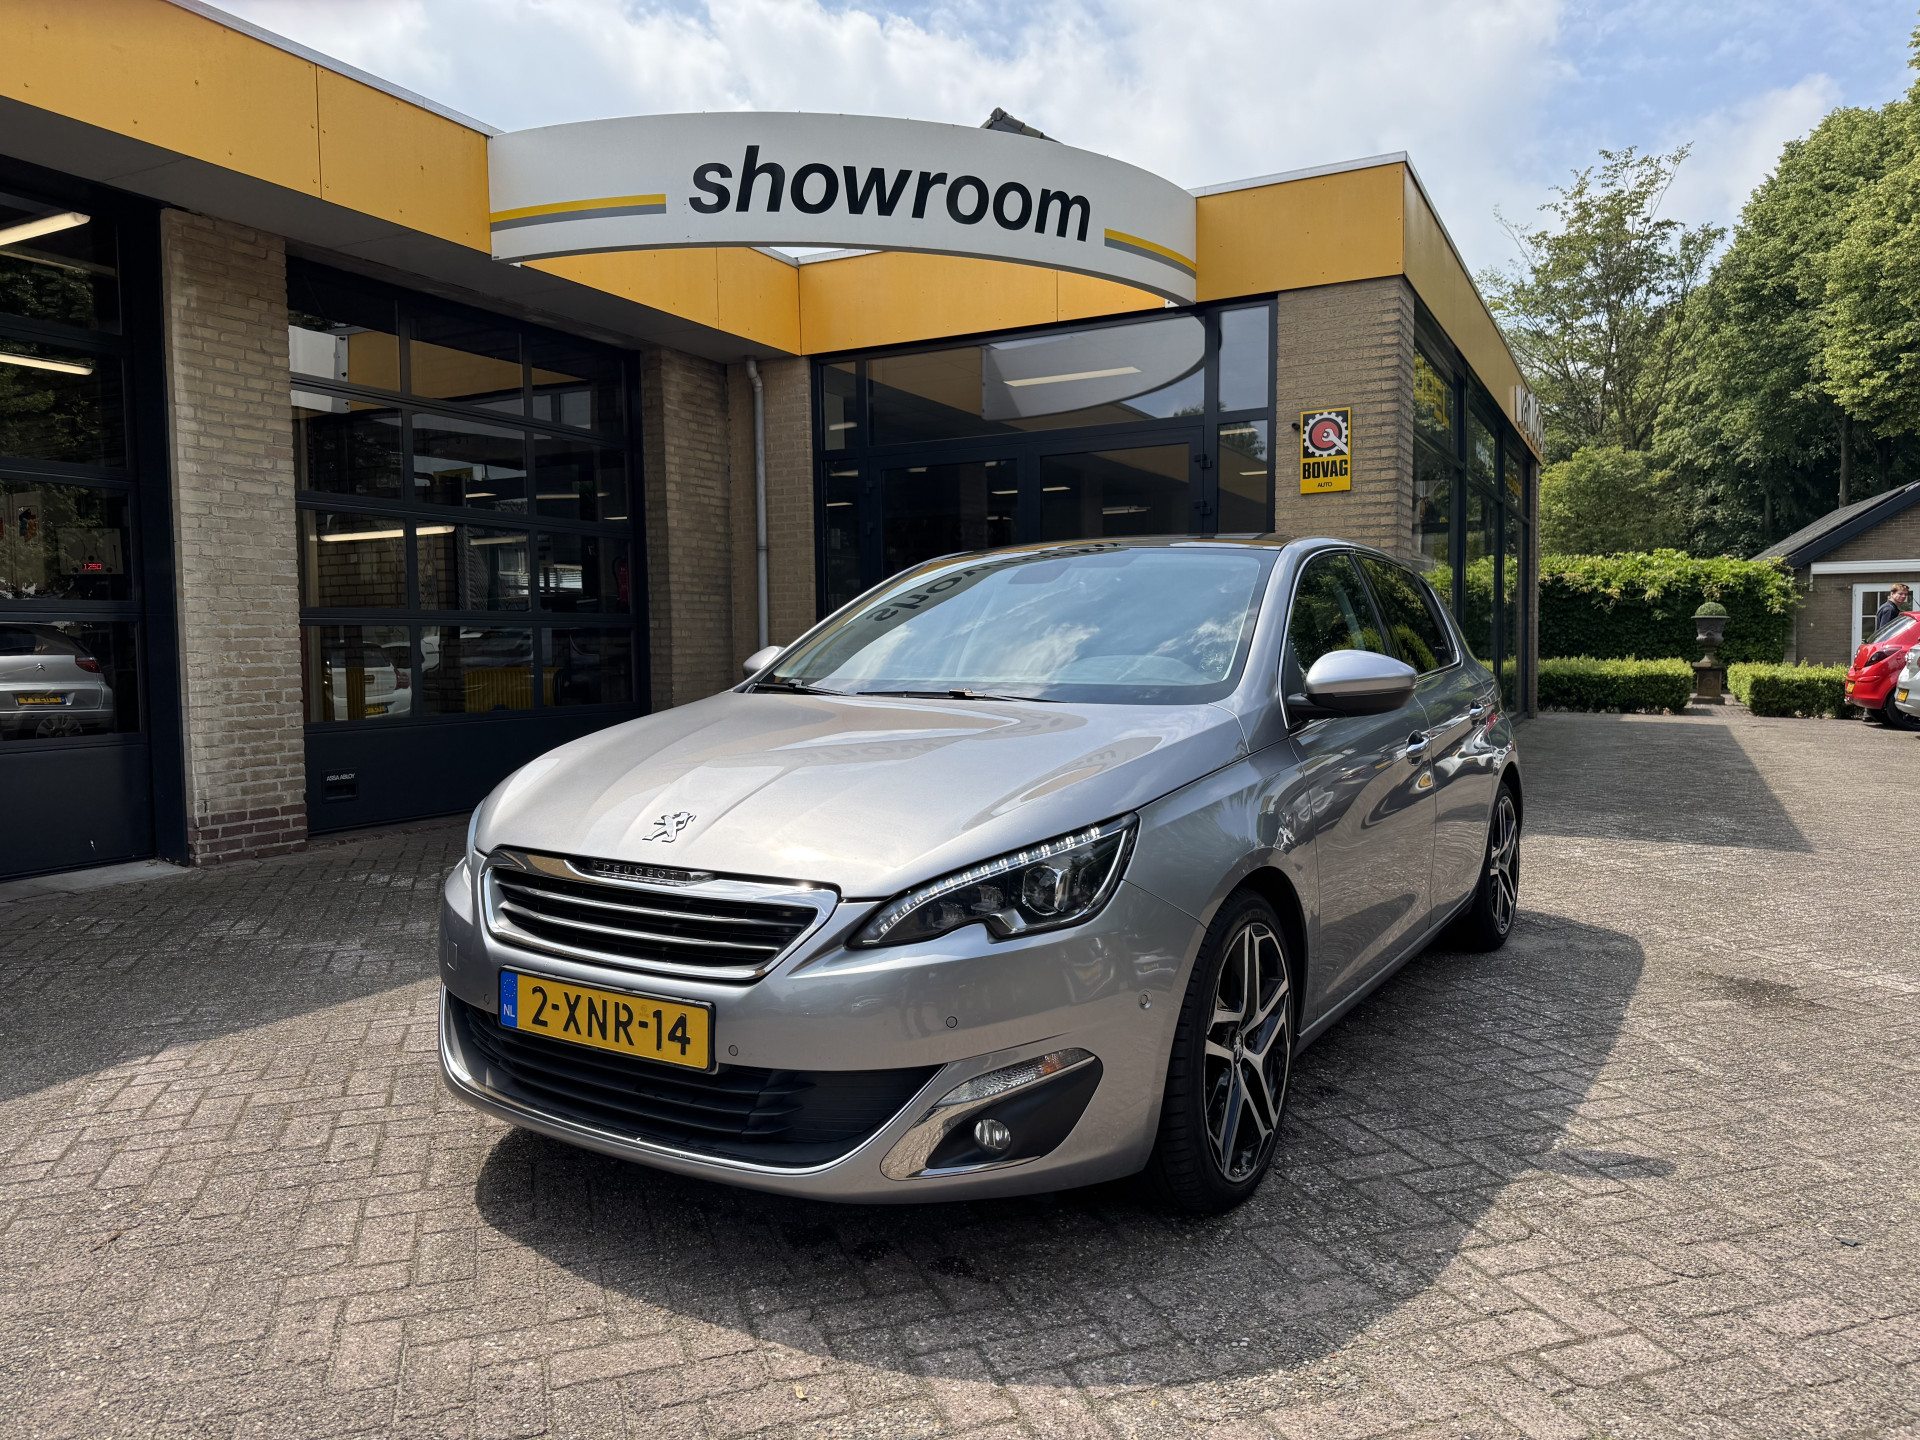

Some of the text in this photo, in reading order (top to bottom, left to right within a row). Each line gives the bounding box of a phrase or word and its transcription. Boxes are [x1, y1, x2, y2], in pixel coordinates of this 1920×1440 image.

[688, 144, 1091, 242] showroom
[1302, 459, 1348, 479] BOVAG
[603, 862, 679, 880] PEUGEOT
[503, 985, 691, 1056] NL 2-XNR-14
